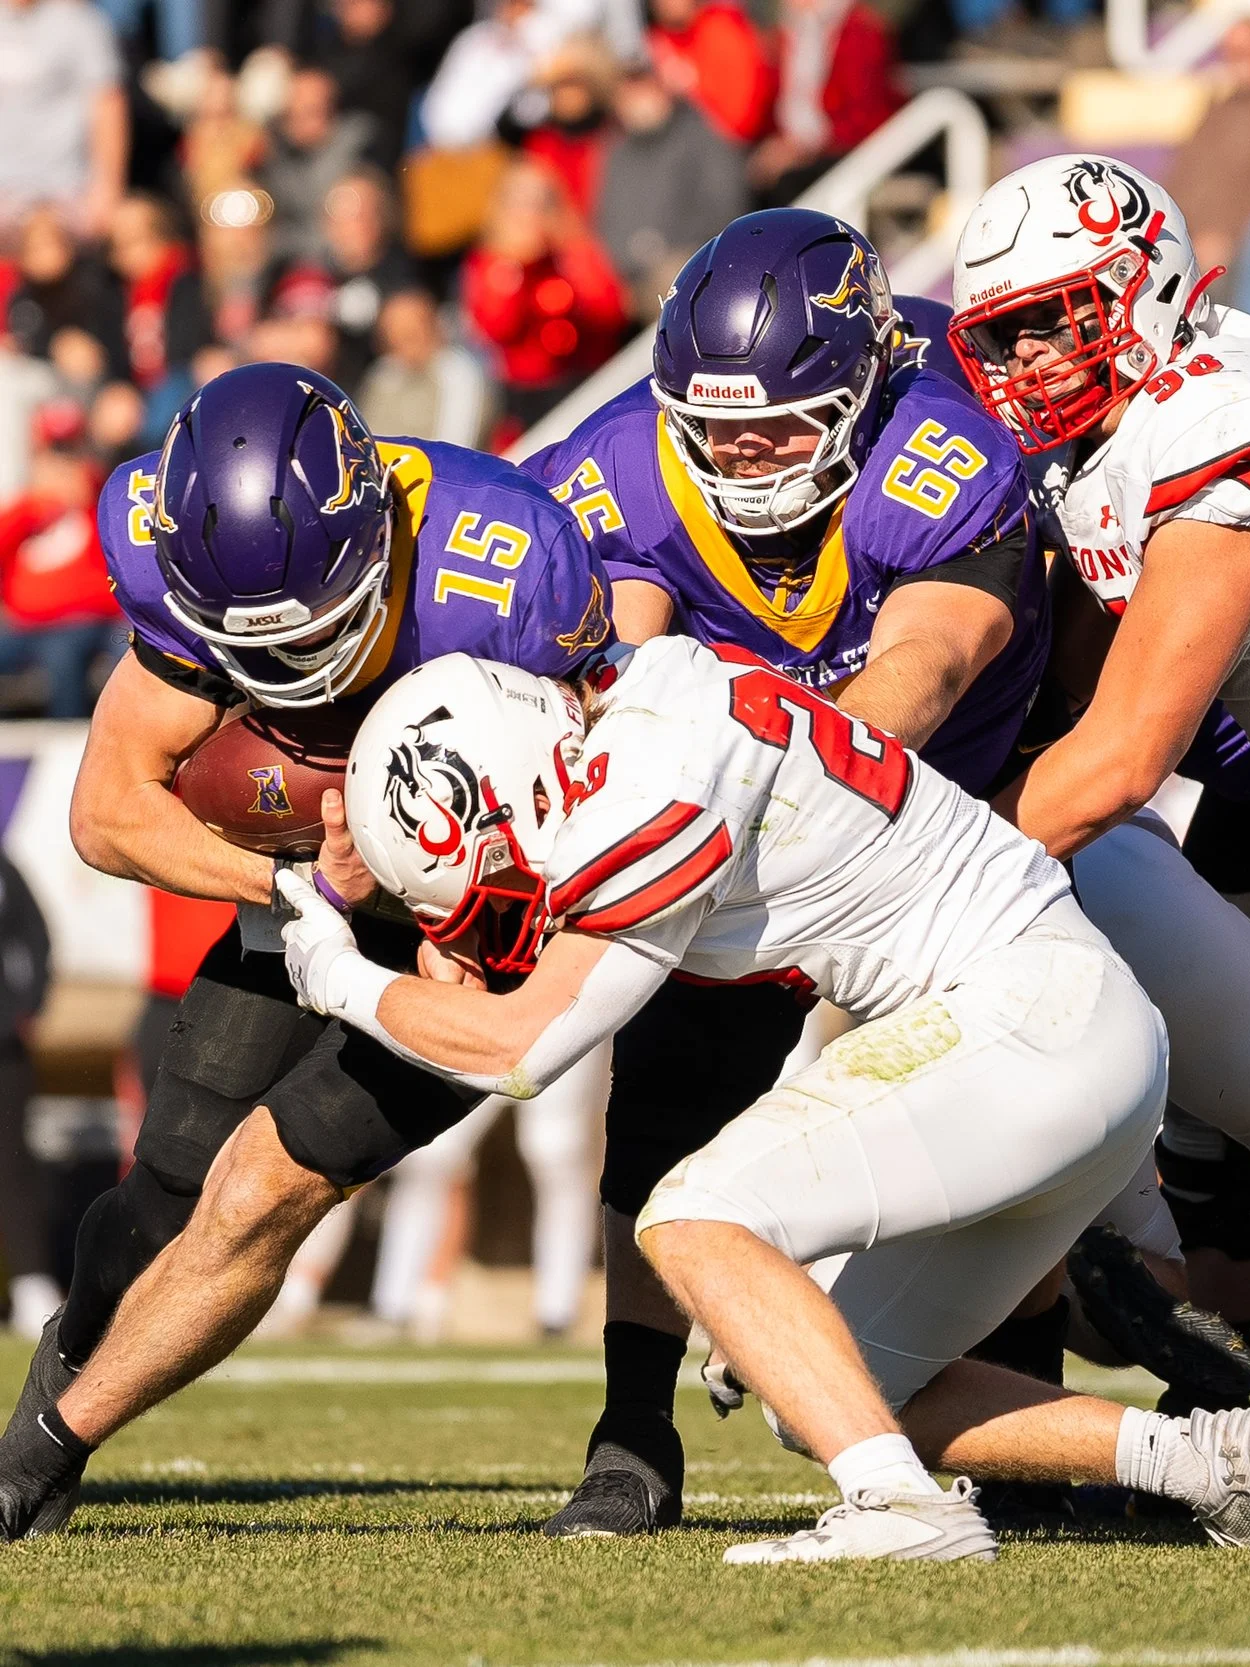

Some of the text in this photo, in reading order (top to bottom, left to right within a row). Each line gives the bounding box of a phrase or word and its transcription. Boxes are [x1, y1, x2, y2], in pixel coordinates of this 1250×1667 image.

[969, 279, 1013, 305] Riddell
[693, 383, 755, 399] Riddell
[881, 417, 989, 520] 65
[433, 510, 532, 618] 15
